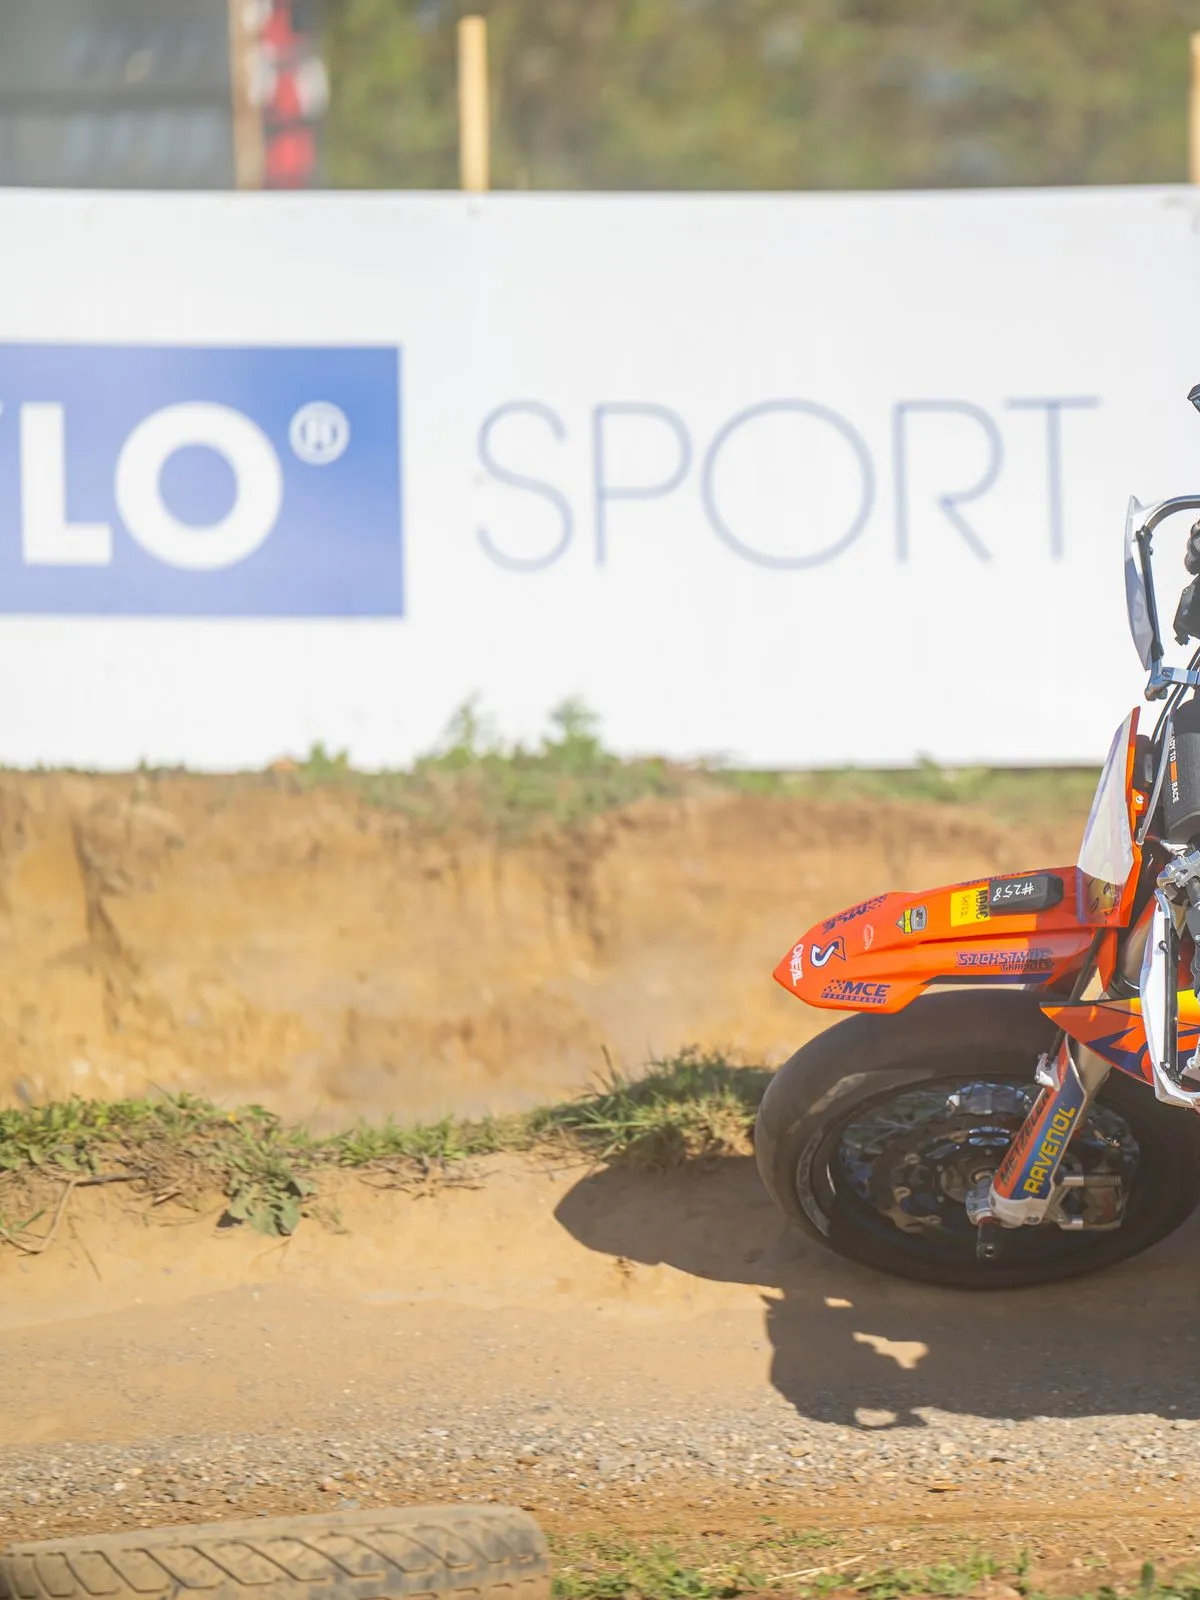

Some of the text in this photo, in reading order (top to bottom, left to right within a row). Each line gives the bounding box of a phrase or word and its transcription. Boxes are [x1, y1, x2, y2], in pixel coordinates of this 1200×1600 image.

[475, 396, 1100, 572] SPORT
[1171, 781, 1180, 804] RACE
[976, 889, 989, 920] ADAC
[992, 881, 1034, 902] #258
[842, 981, 891, 997] MCE
[1023, 1105, 1077, 1194] RAVENOL
